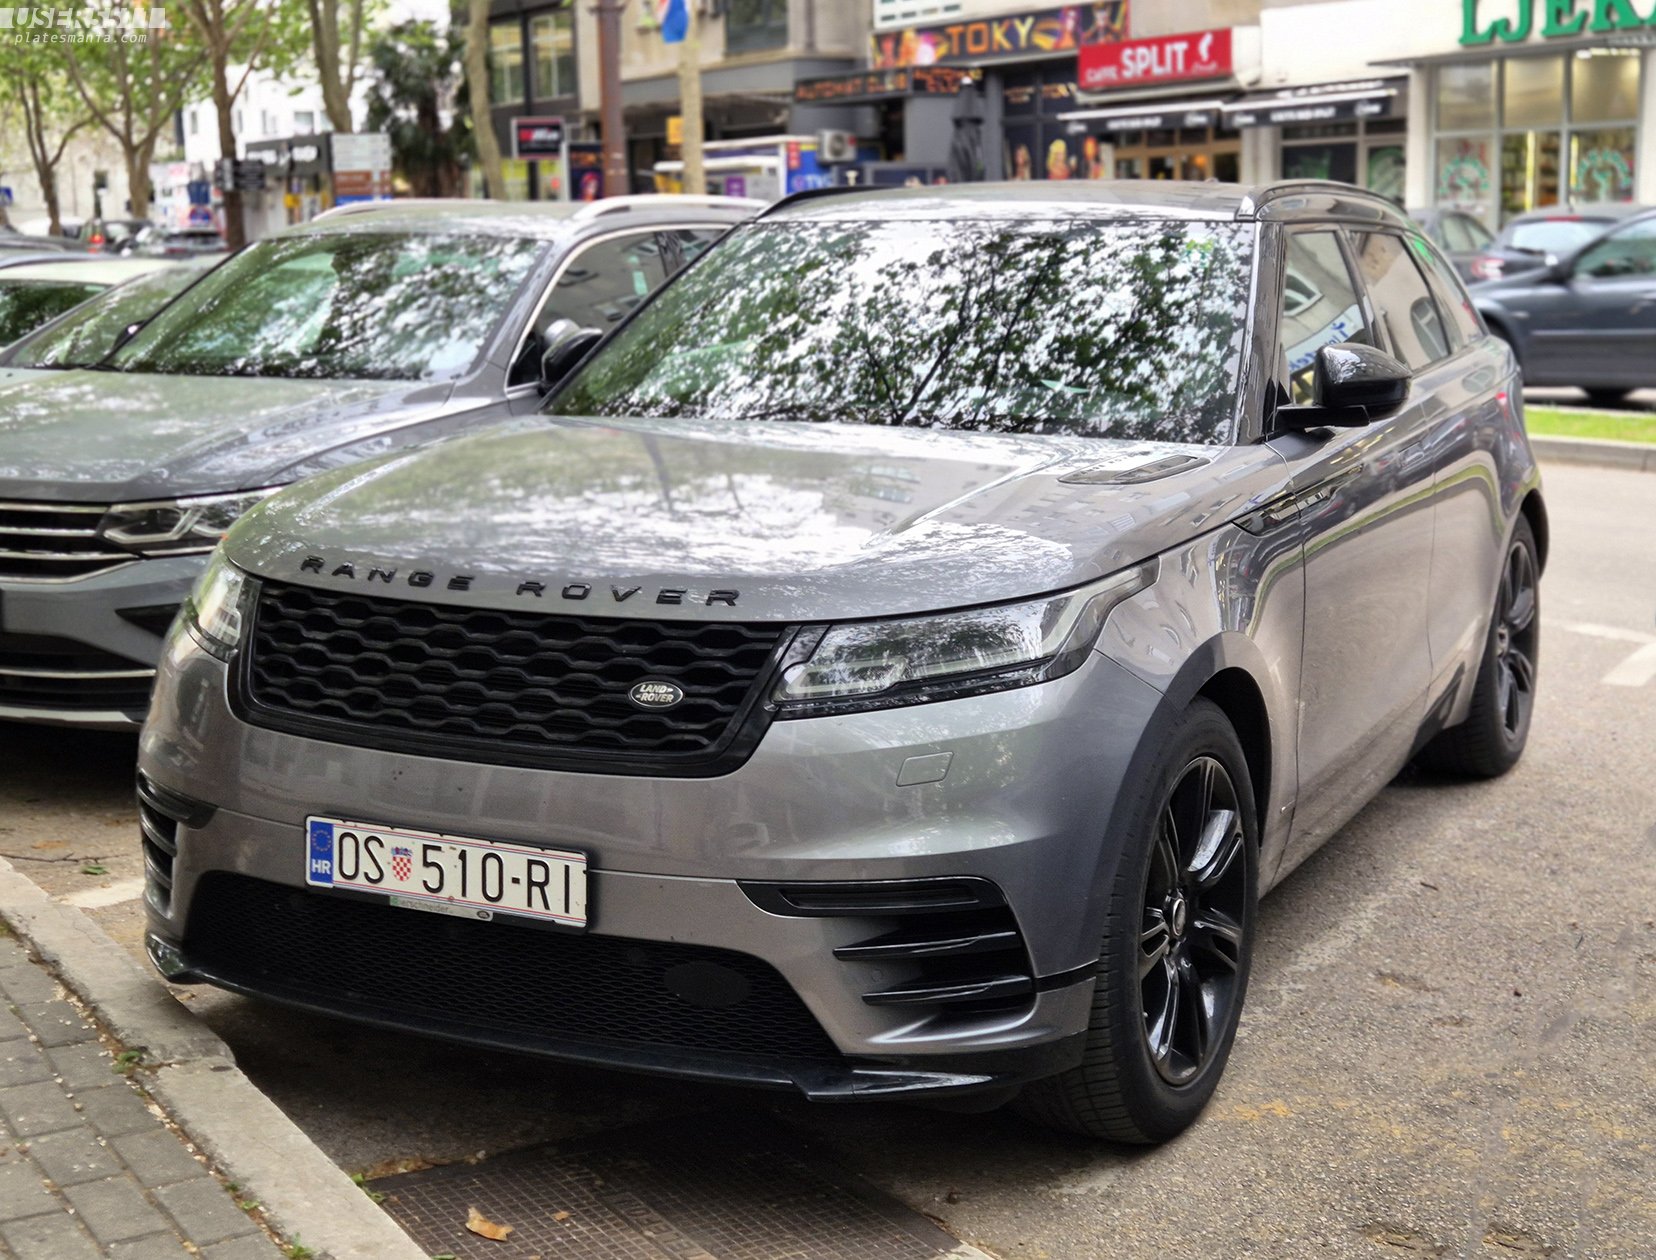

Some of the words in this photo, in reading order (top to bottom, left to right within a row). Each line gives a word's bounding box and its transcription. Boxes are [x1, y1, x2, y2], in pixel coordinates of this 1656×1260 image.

[945, 16, 1035, 55] TOKY
[1458, 0, 1656, 45] LJEK
[1121, 41, 1188, 78] SPLIT
[300, 555, 475, 592] RANGE
[516, 580, 742, 607] ROVER
[312, 858, 331, 875] HR
[338, 832, 385, 884] OS
[422, 844, 570, 914] 510-RI
